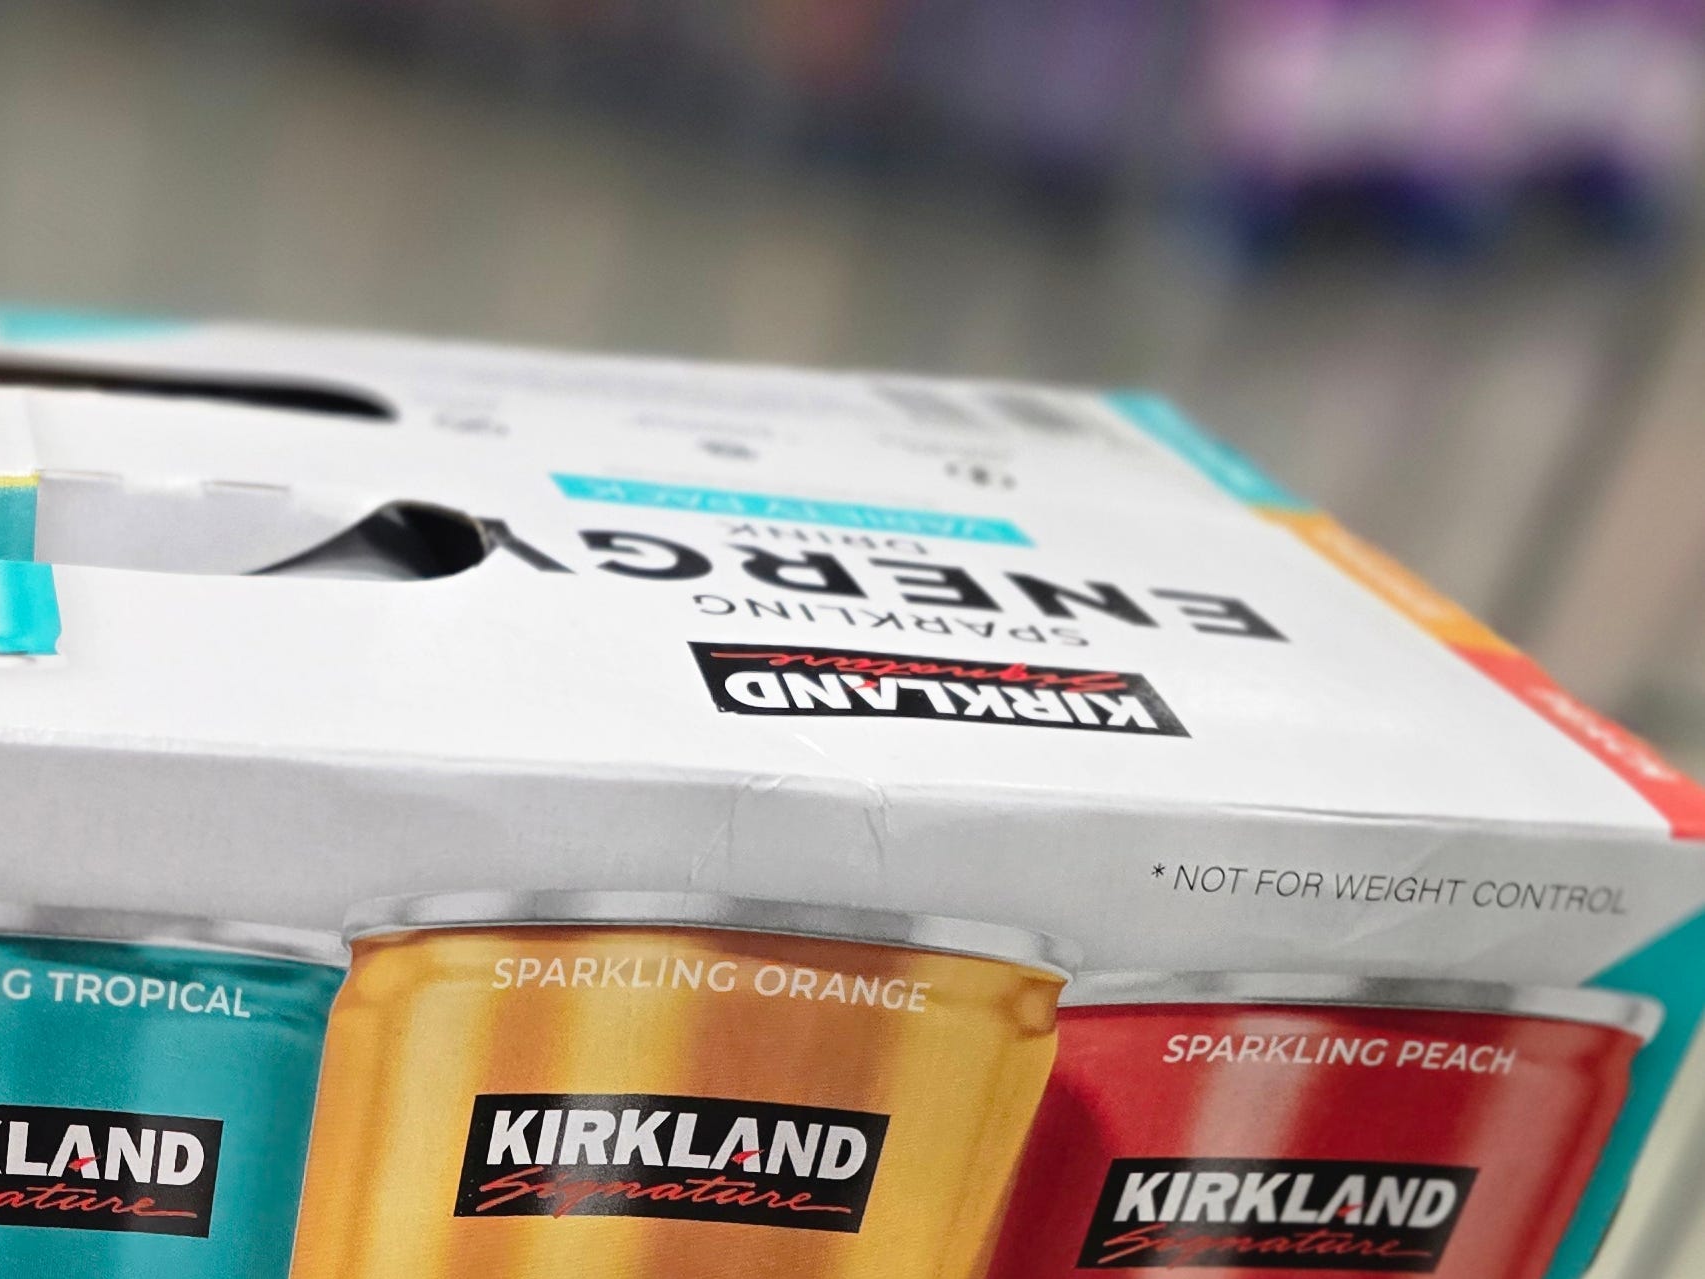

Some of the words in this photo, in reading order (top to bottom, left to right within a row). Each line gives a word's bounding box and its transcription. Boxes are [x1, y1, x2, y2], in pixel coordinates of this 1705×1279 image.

[723, 523, 926, 555] DRINK
[692, 594, 1088, 647] SPARKLING
[725, 670, 1161, 731] KIRKLAND
[1173, 865, 1248, 893] NOT
[1255, 870, 1324, 898] FOR
[1334, 874, 1465, 904] WEIGHT
[1472, 880, 1628, 915] CONTROL
[47, 971, 251, 1018] TROPICAL
[491, 957, 737, 993] SPARKLING
[754, 966, 931, 1014] ORANGE
[1162, 1034, 1389, 1068] SPARKLING
[1397, 1041, 1515, 1075] PEACH
[486, 1109, 867, 1179] KIRKLAND
[477, 1166, 852, 1219] Signature
[1114, 1171, 1458, 1229] KIRKLAND
